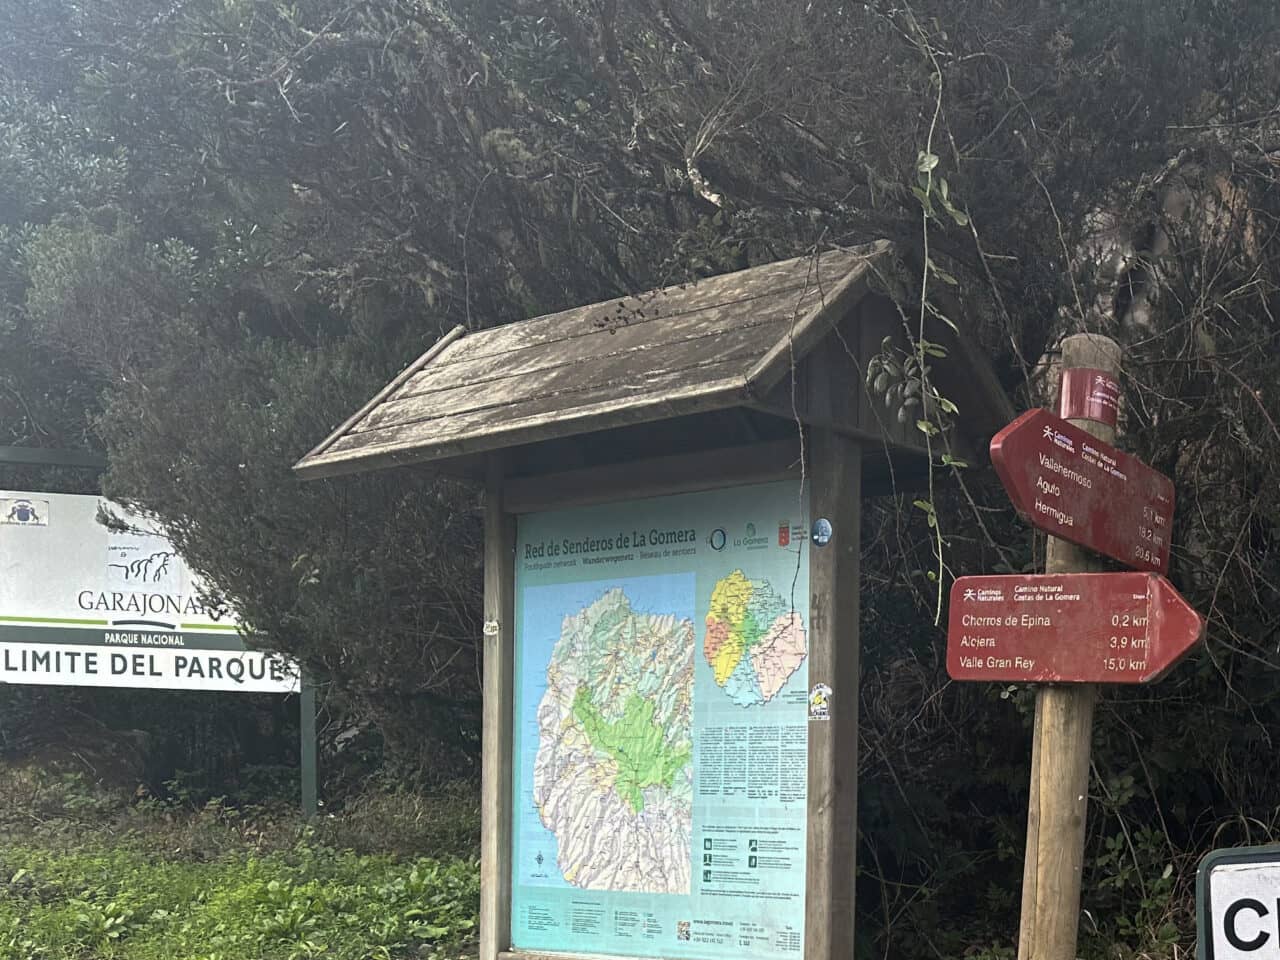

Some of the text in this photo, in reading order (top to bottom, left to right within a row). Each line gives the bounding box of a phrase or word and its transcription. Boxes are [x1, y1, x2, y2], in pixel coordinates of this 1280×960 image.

[1082, 442, 1117, 466] Camino Natural
[1039, 452, 1092, 489] Vallehermoso
[1081, 451, 1126, 481] Costas de La Gomera
[1036, 475, 1060, 497] Agulo
[1034, 497, 1074, 527] Hermigua
[1155, 511, 1166, 526] km
[524, 543, 545, 560] Red
[547, 539, 560, 557] de
[562, 536, 613, 555] Senderos
[616, 532, 630, 550] de
[633, 530, 647, 548] La
[649, 527, 697, 546] Gomera
[1152, 533, 1163, 547] km
[1151, 553, 1161, 567] km
[1014, 584, 1063, 593] Camino Natural
[78, 590, 208, 617] GARAJONA
[1054, 593, 1080, 601] Gomera
[962, 614, 1051, 629] Chorros de Epina
[1111, 614, 1149, 628] 0,2 km
[104, 632, 185, 647] PARQUE NACIONAL
[960, 635, 996, 650] Alojera
[1109, 636, 1149, 651] 3,9 km
[4, 649, 286, 684] LIMITE DEL PARQUE
[959, 656, 1036, 671] Valle Gran Rey
[1103, 658, 1146, 672] 15,0 km
